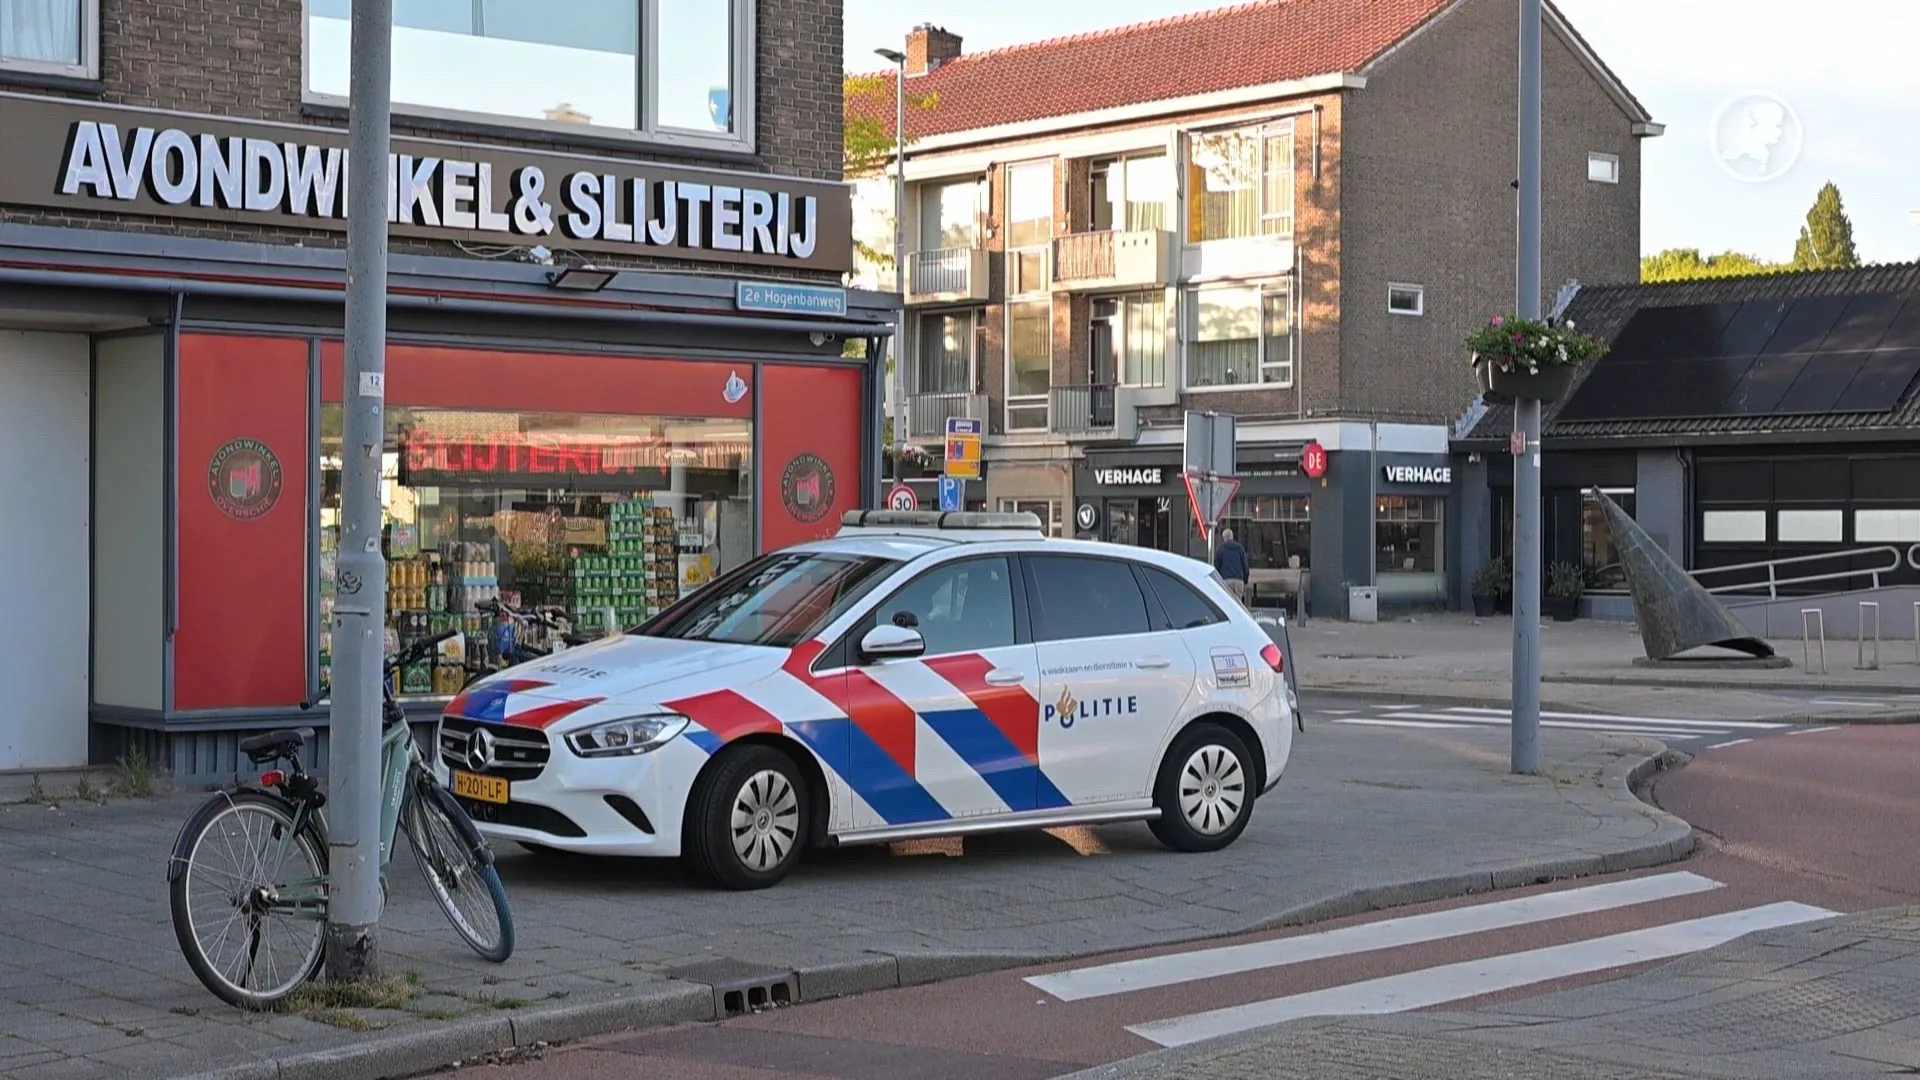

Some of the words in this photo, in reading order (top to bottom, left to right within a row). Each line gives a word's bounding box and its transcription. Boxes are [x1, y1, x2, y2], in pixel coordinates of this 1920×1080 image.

[58, 119, 509, 230] AVONDWIKEL
[509, 165, 555, 236] &
[564, 171, 817, 259] SLIJTERIJ
[744, 287, 760, 302] 2e
[764, 288, 841, 312] Hogenbanweg
[369, 375, 380, 386] 12
[211, 440, 280, 478] AVONDWINKEL
[1094, 468, 1162, 485] VERHAGE
[1386, 465, 1452, 483] VERHAGE
[943, 479, 955, 496] P
[894, 498, 912, 511] 30
[1044, 695, 1138, 729] POLITIE
[456, 775, 502, 799] H-201-LF
